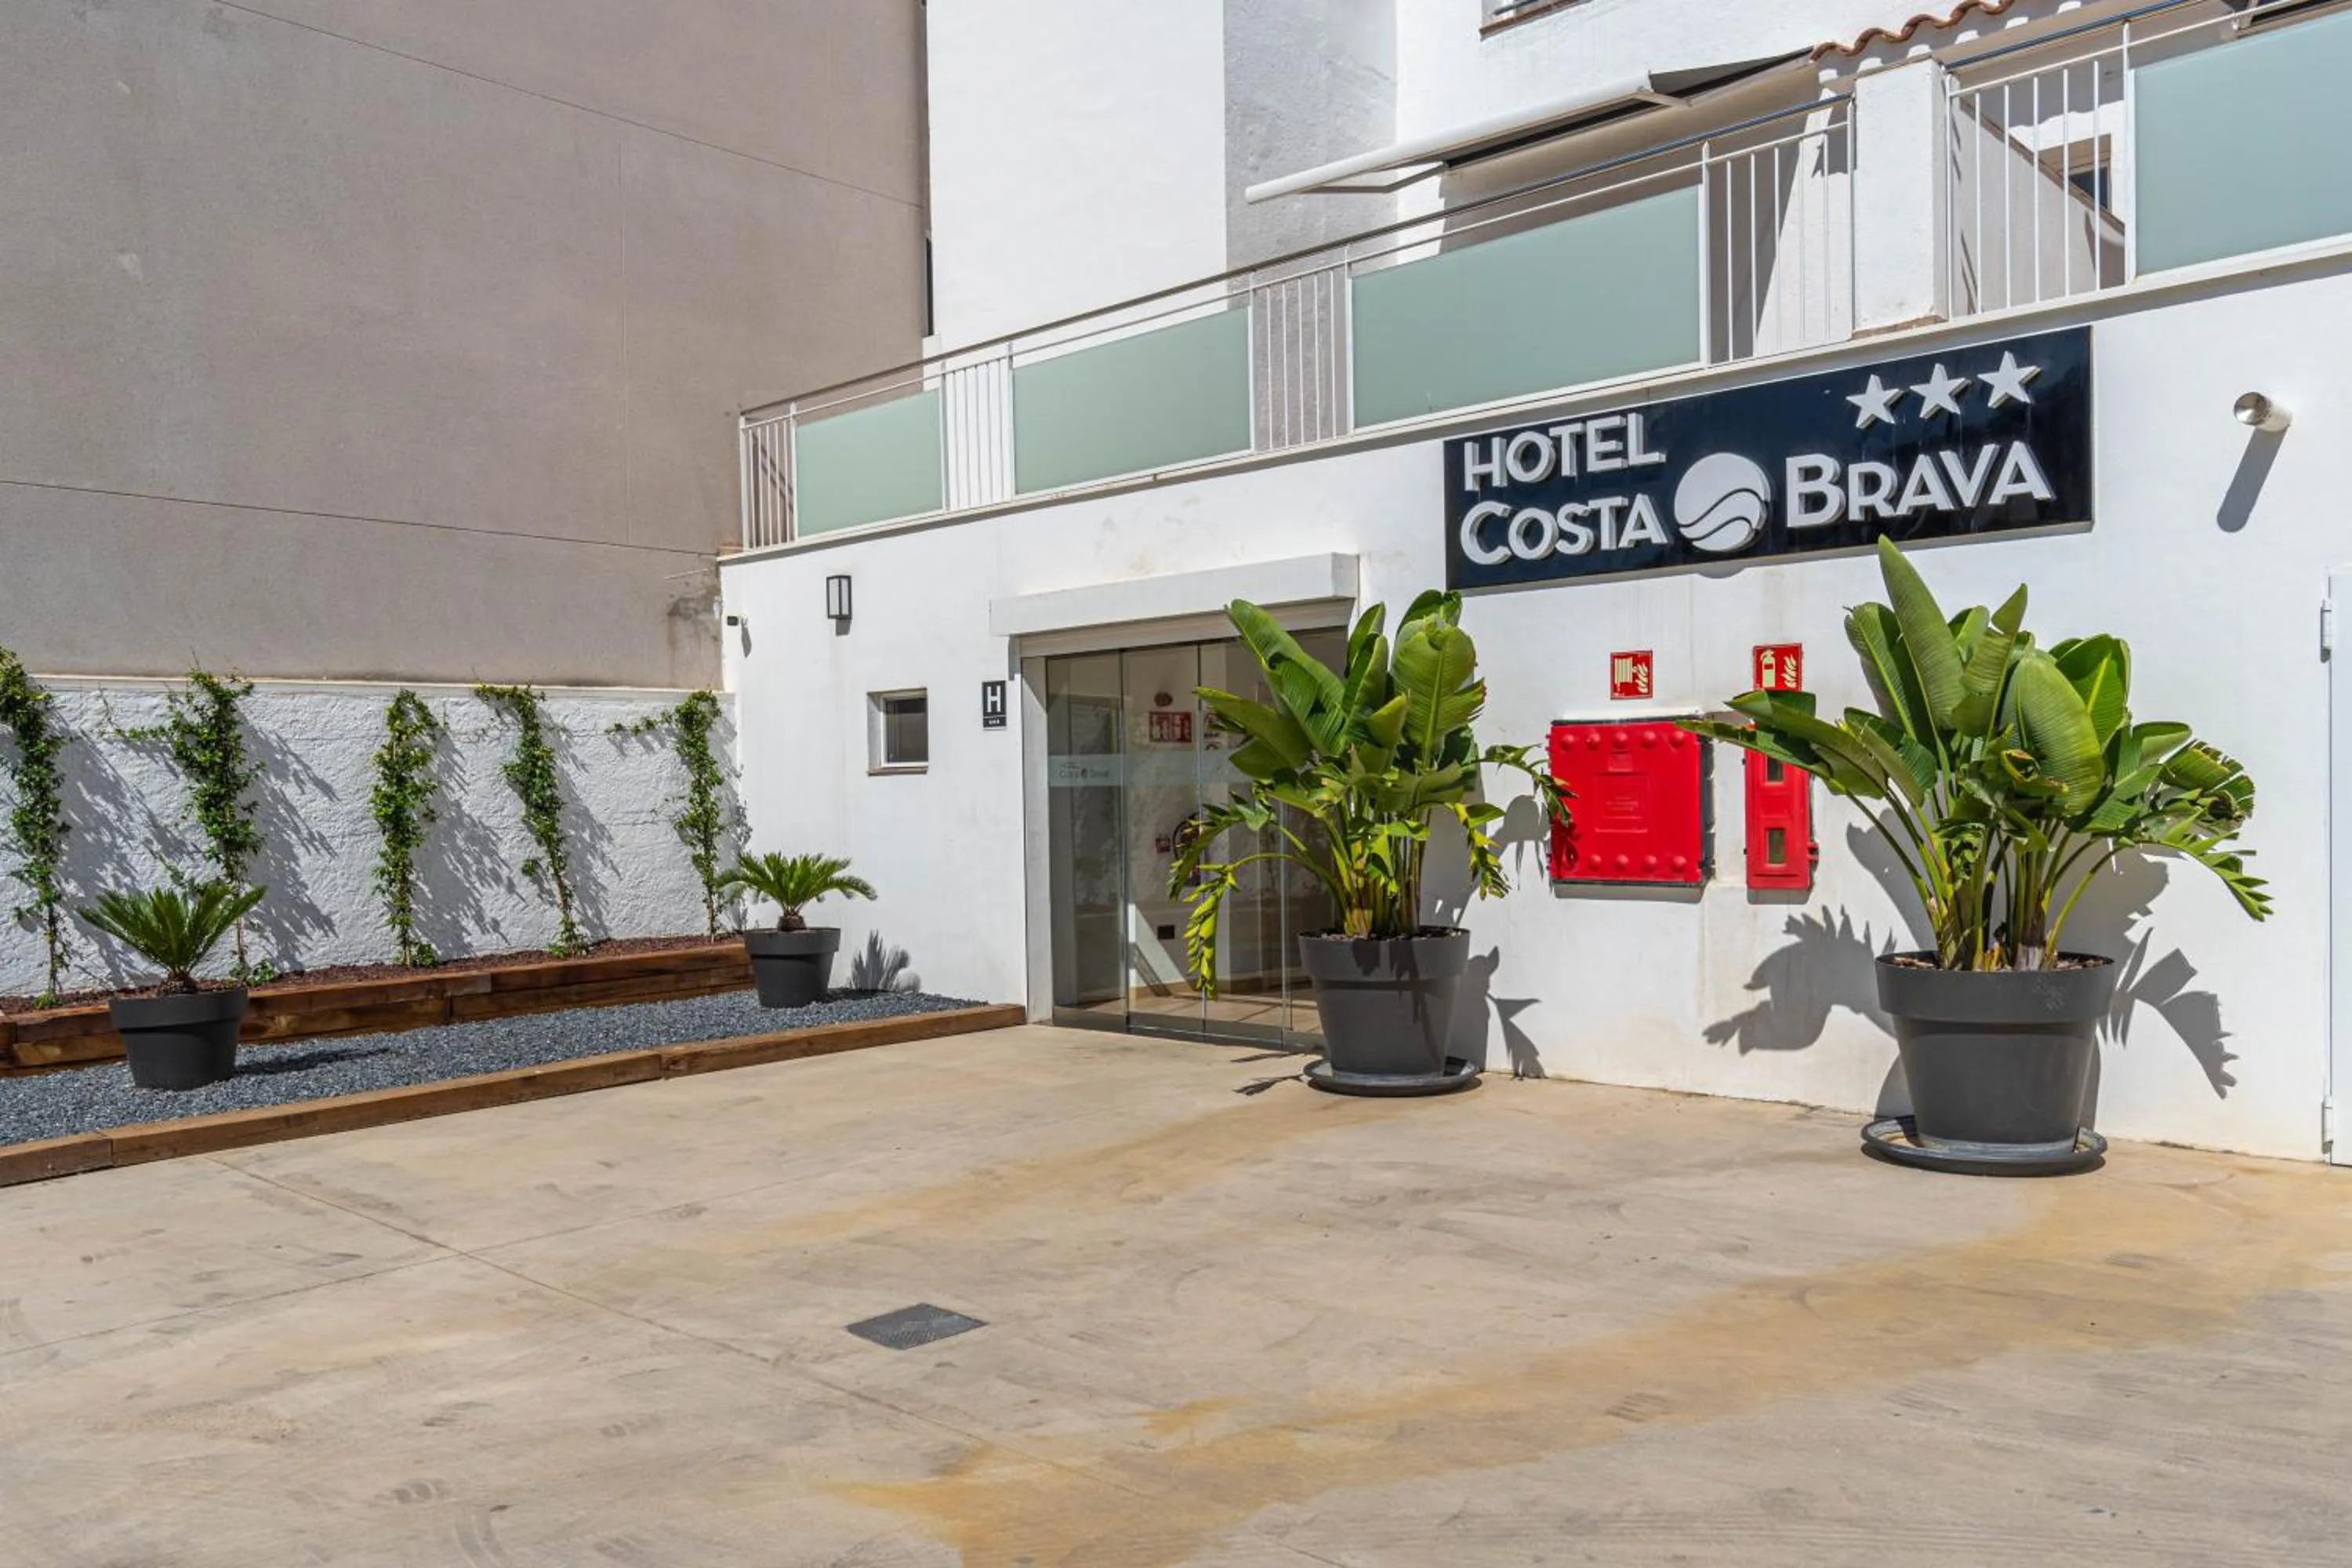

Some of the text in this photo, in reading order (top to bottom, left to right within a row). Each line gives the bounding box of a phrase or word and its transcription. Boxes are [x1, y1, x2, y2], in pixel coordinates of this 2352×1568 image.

[1465, 412, 1666, 491] HOTEL
[1461, 440, 2056, 565] COSTA BRAVA
[987, 684, 1001, 713] H
